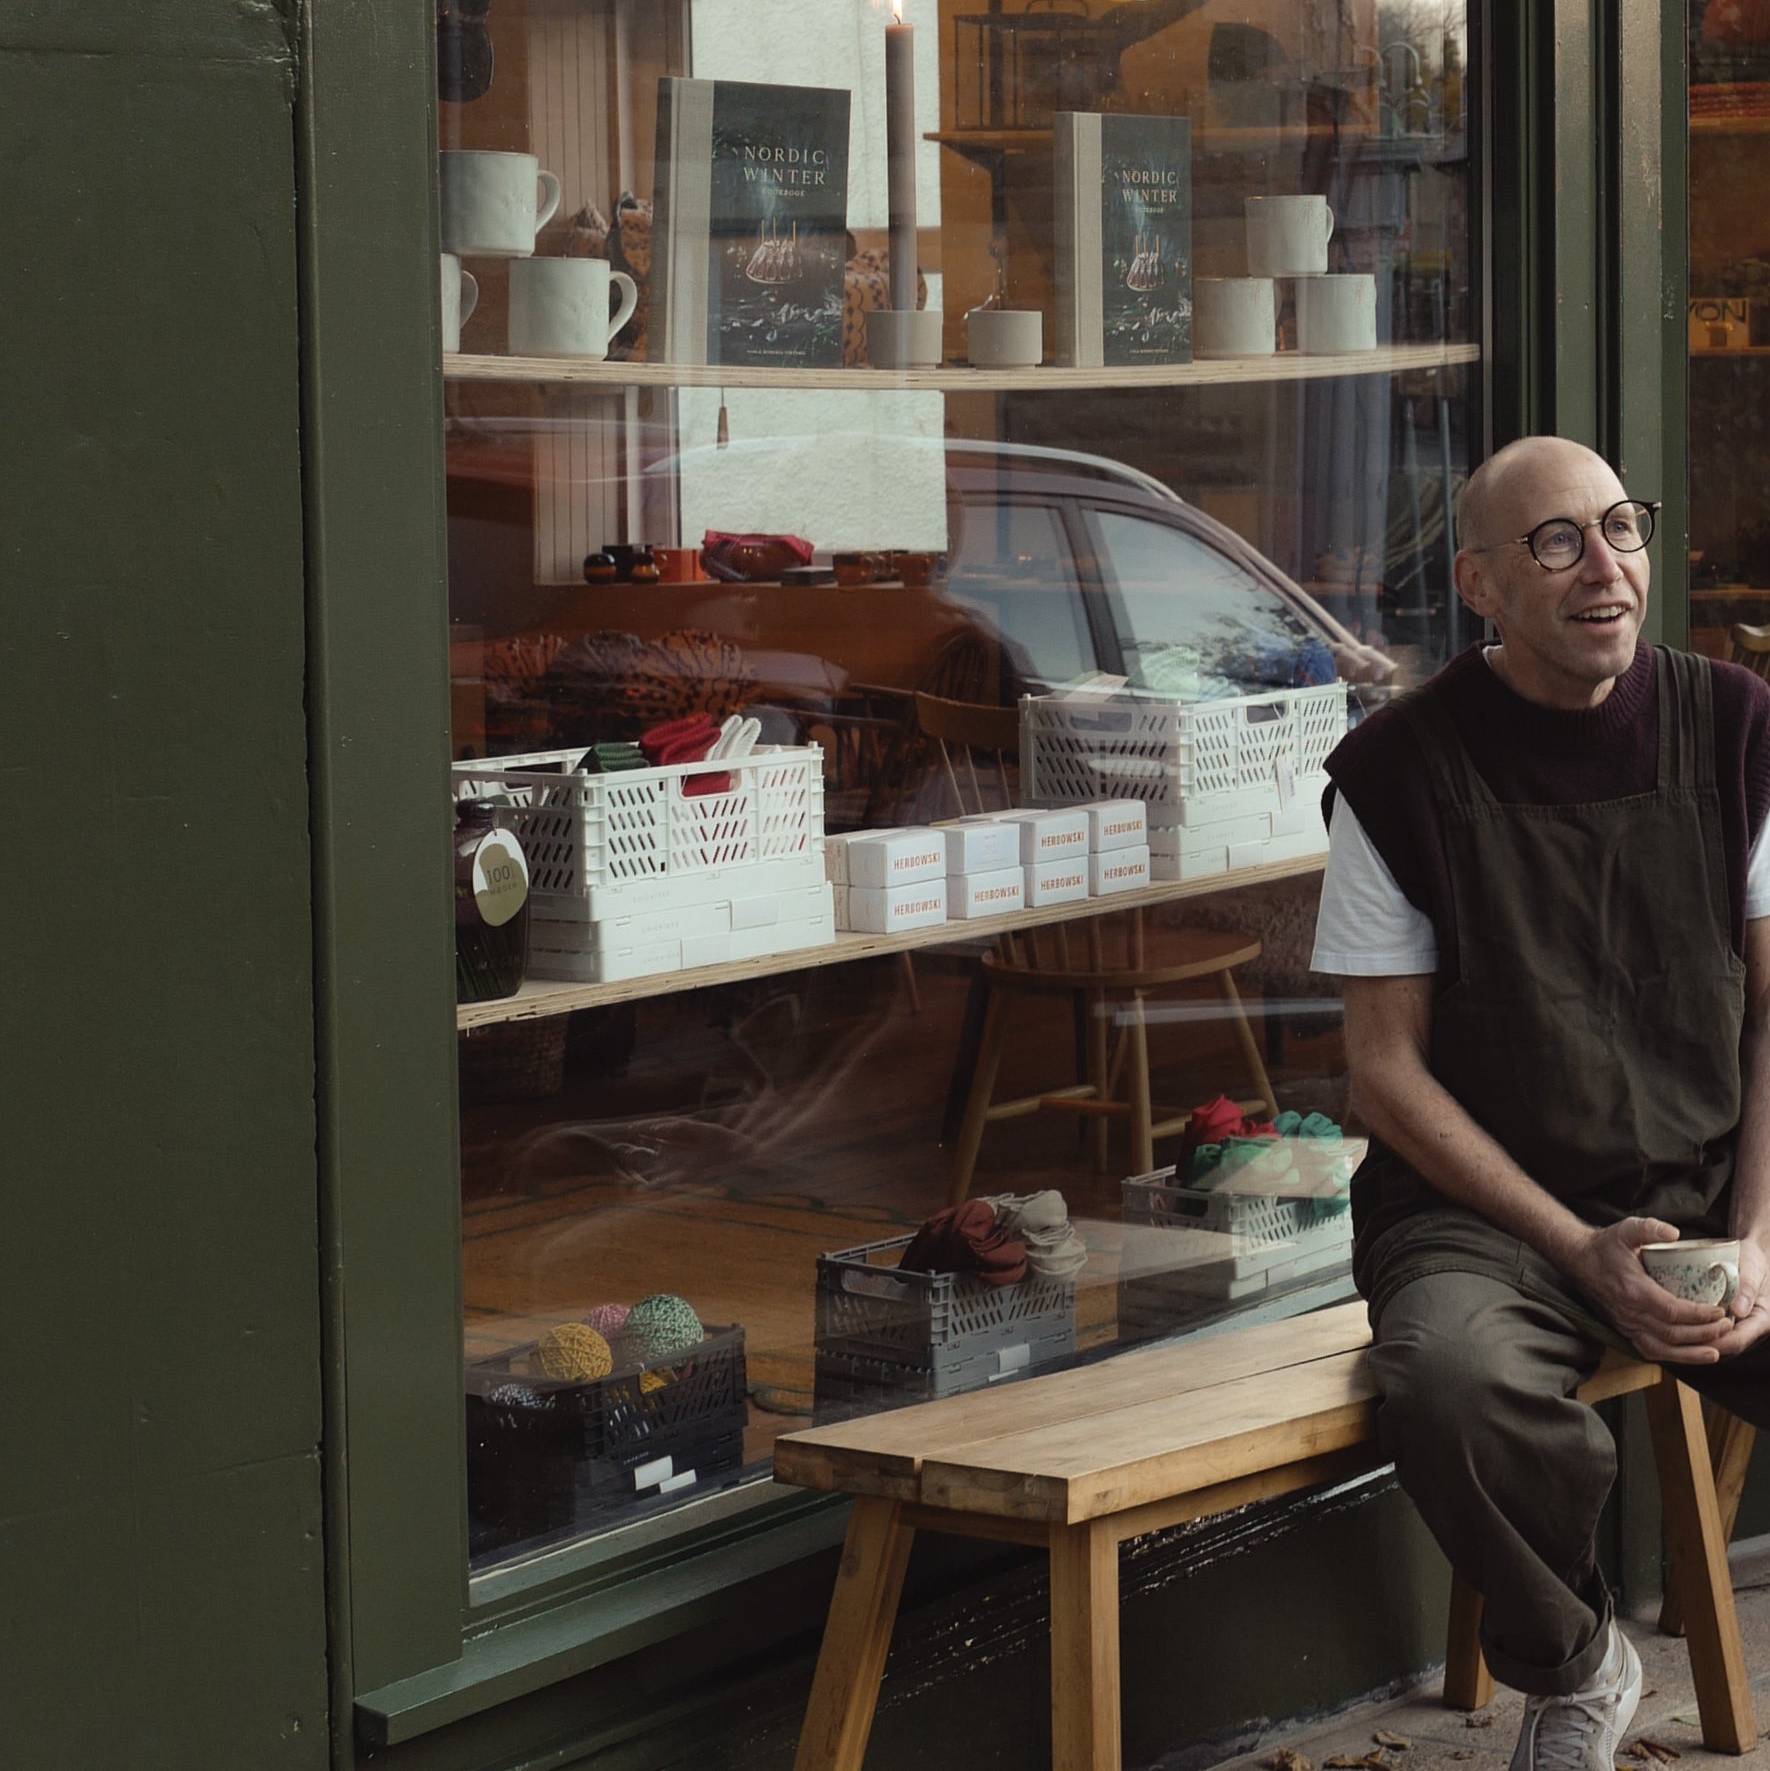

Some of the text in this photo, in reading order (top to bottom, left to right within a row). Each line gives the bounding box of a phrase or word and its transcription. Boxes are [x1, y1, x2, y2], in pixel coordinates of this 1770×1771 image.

[744, 145, 825, 165] NORDIC
[743, 166, 825, 185] WINTER
[1122, 170, 1176, 184] NORDIC
[1120, 188, 1177, 203] WINTER
[1041, 831, 1085, 848] HERBOWSKI
[893, 852, 941, 870] HERBOWSKI
[1104, 863, 1146, 881] HERBOWSKI
[1040, 875, 1084, 892] HERBOWSKI
[974, 885, 1020, 903] HERBOWSKI
[893, 899, 941, 917] HERBOWSKI
